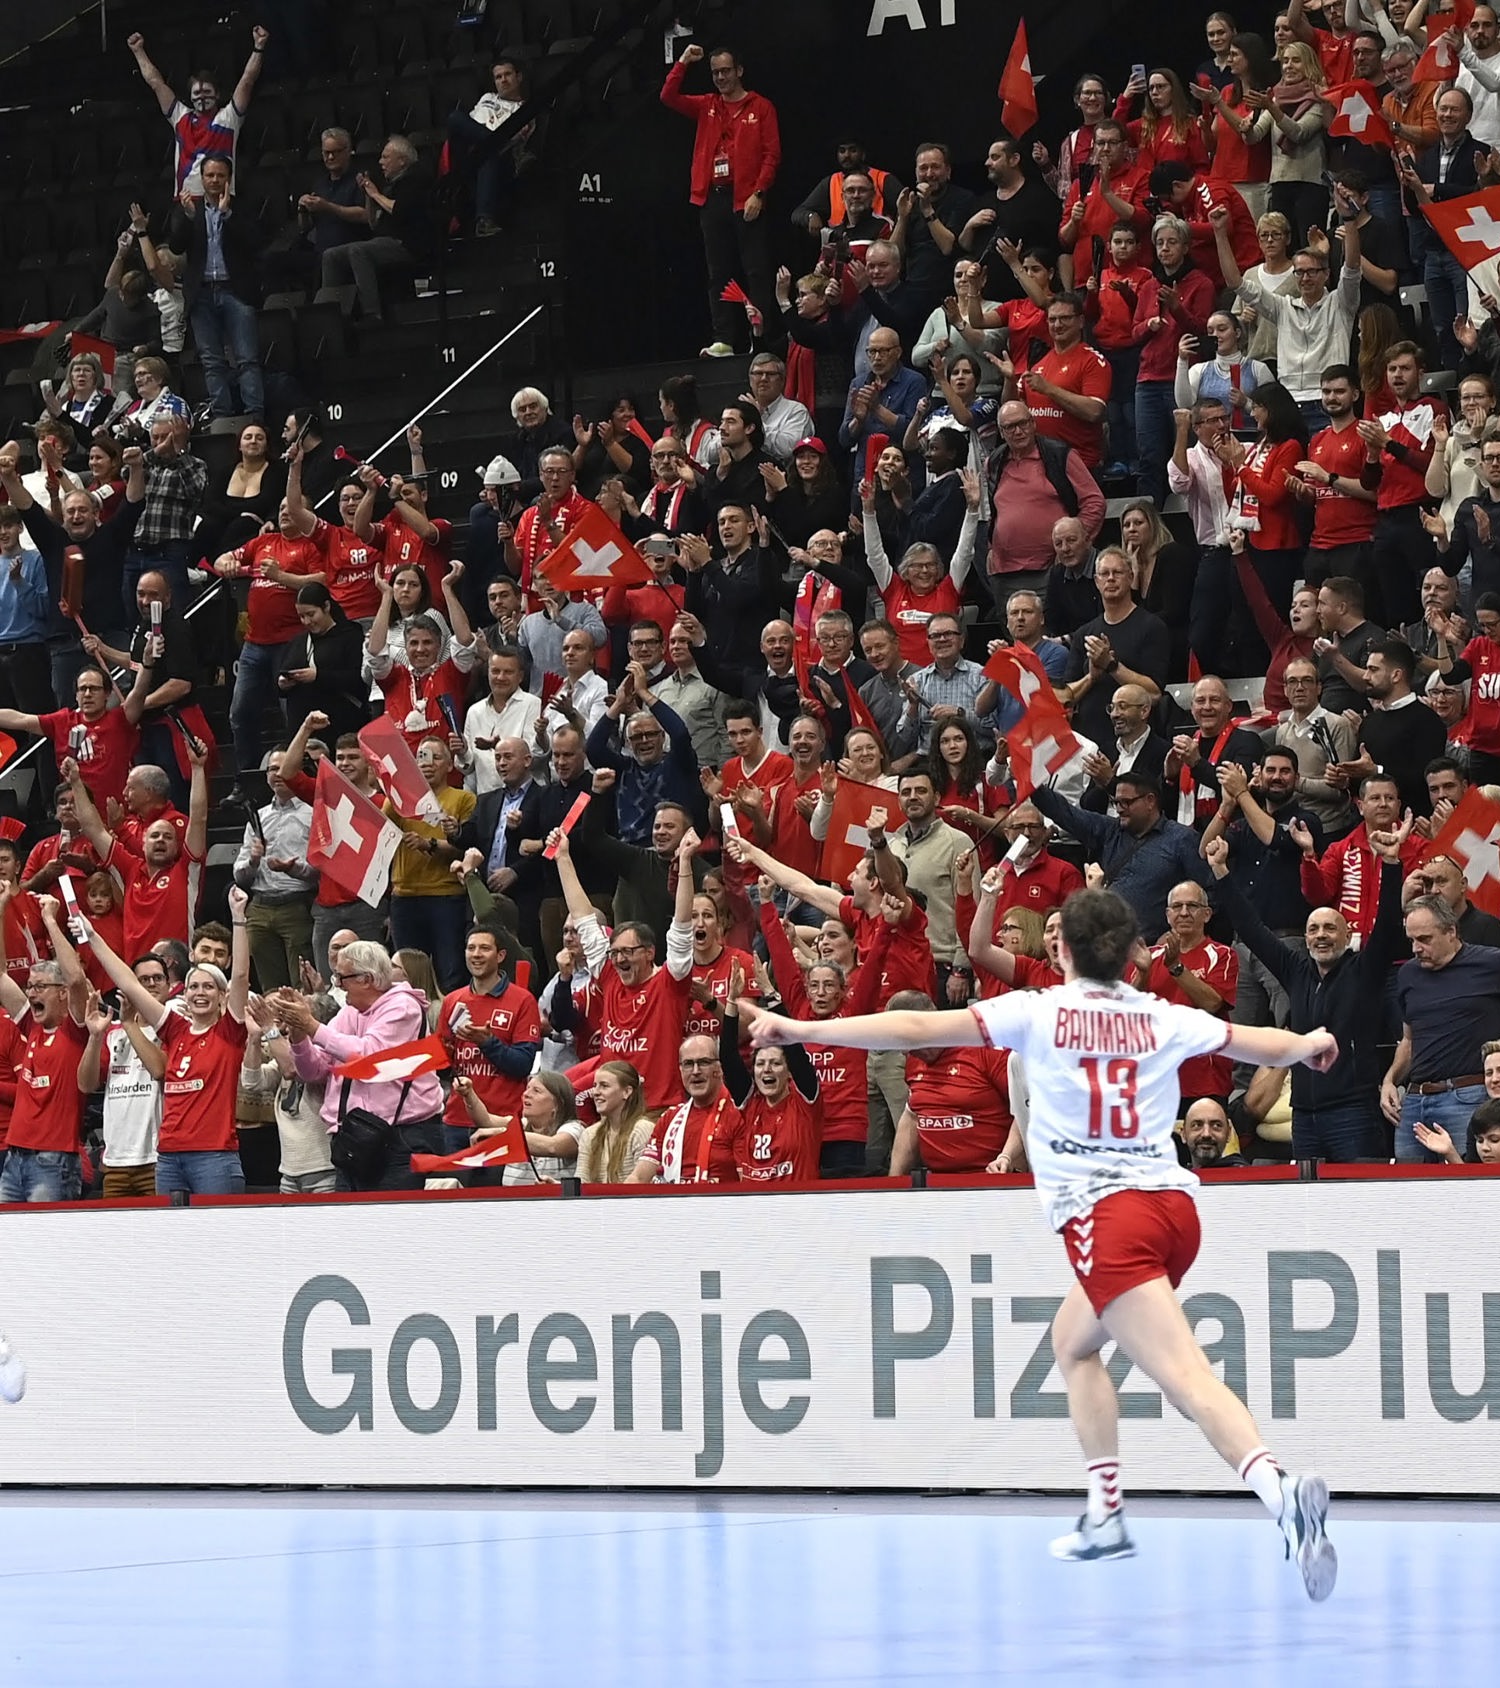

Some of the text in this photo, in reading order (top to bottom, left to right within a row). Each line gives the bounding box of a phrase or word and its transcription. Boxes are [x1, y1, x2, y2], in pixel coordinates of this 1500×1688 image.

[579, 173, 600, 192] A1
[540, 261, 555, 278] 12
[443, 347, 455, 363] 11
[327, 404, 342, 420] 10
[441, 471, 458, 488] 09
[1054, 1007, 1156, 1054] BAUMANN
[176, 1055, 191, 1078] 5
[1078, 1057, 1139, 1139] 13
[919, 1118, 954, 1128] SPAR
[283, 1271, 812, 1478] Gorenje
